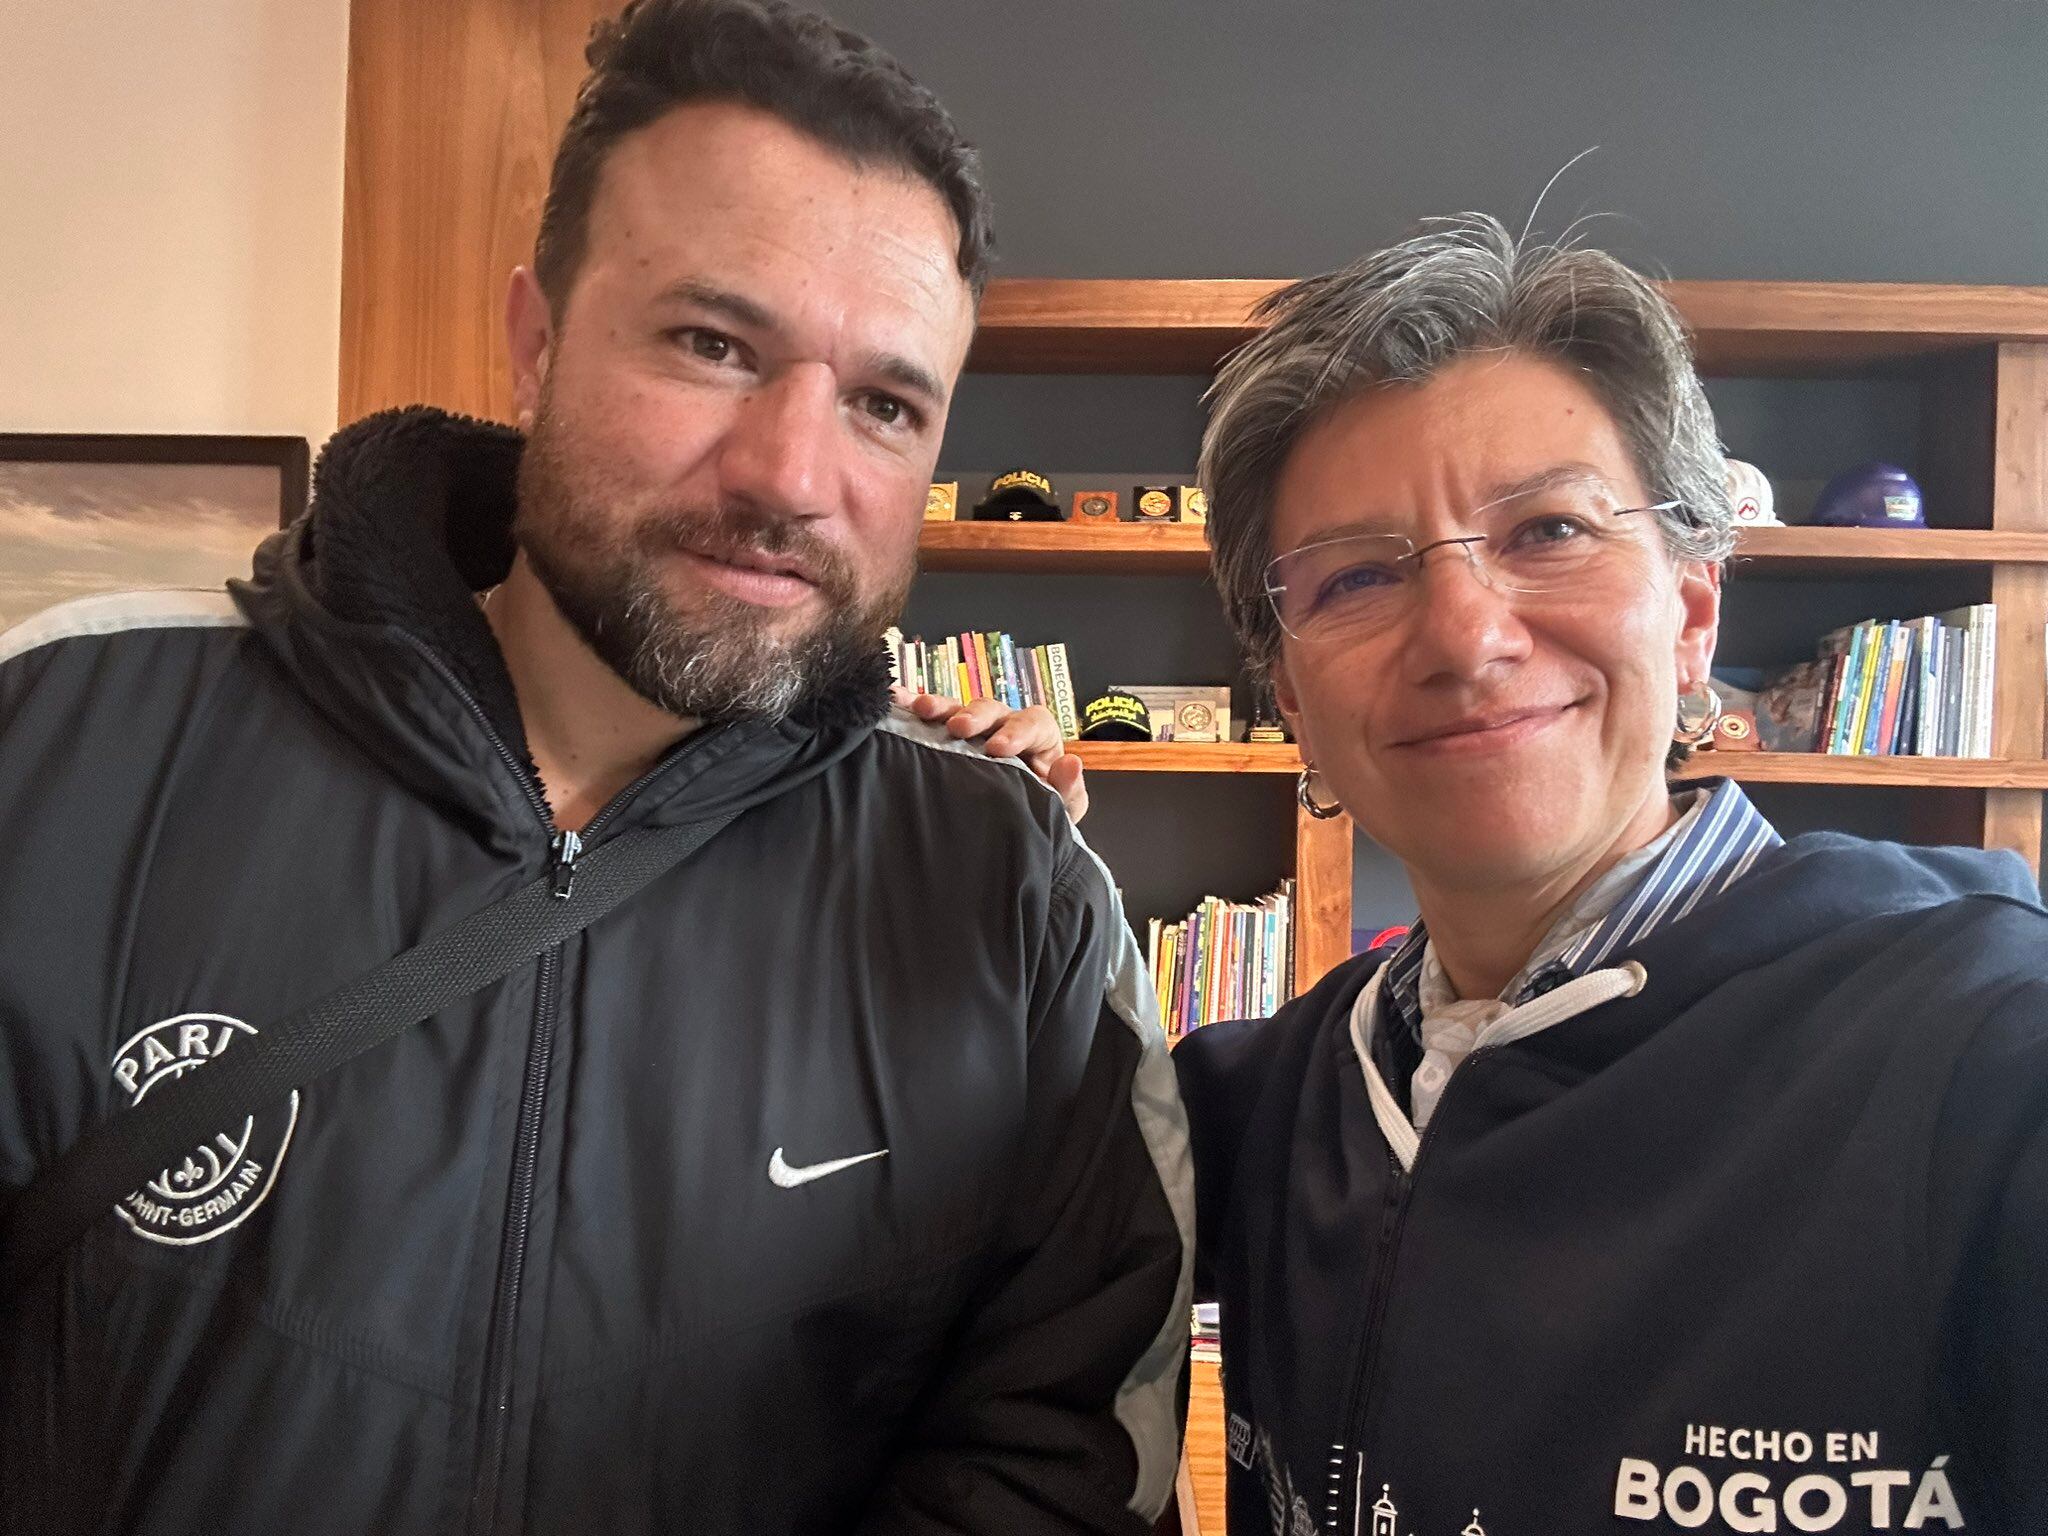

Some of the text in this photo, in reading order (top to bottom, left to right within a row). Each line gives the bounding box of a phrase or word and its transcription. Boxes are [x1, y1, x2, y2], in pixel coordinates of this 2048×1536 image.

[113, 1023, 234, 1094] PARI
[1684, 1423, 1879, 1463] HECHO EN
[1614, 1455, 1965, 1534] BOGOTÁ
